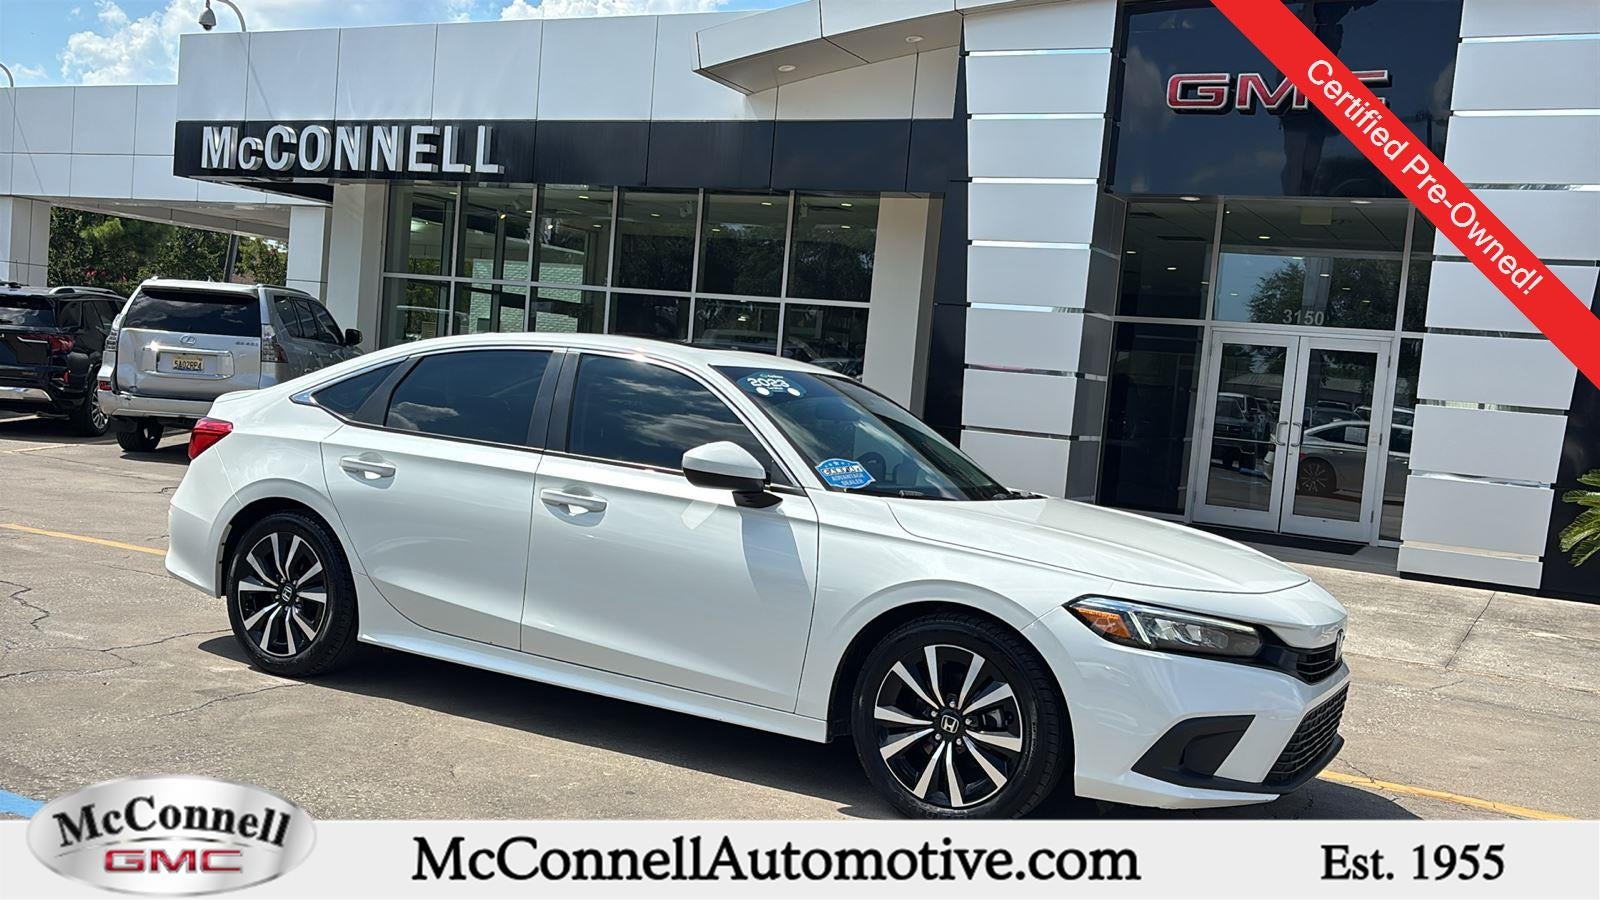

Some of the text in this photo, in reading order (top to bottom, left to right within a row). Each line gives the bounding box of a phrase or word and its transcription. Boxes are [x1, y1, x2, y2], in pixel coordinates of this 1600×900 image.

[200, 123, 505, 174] McCONNELL
[1281, 308, 1326, 326] 3150
[746, 377, 790, 388] 2023
